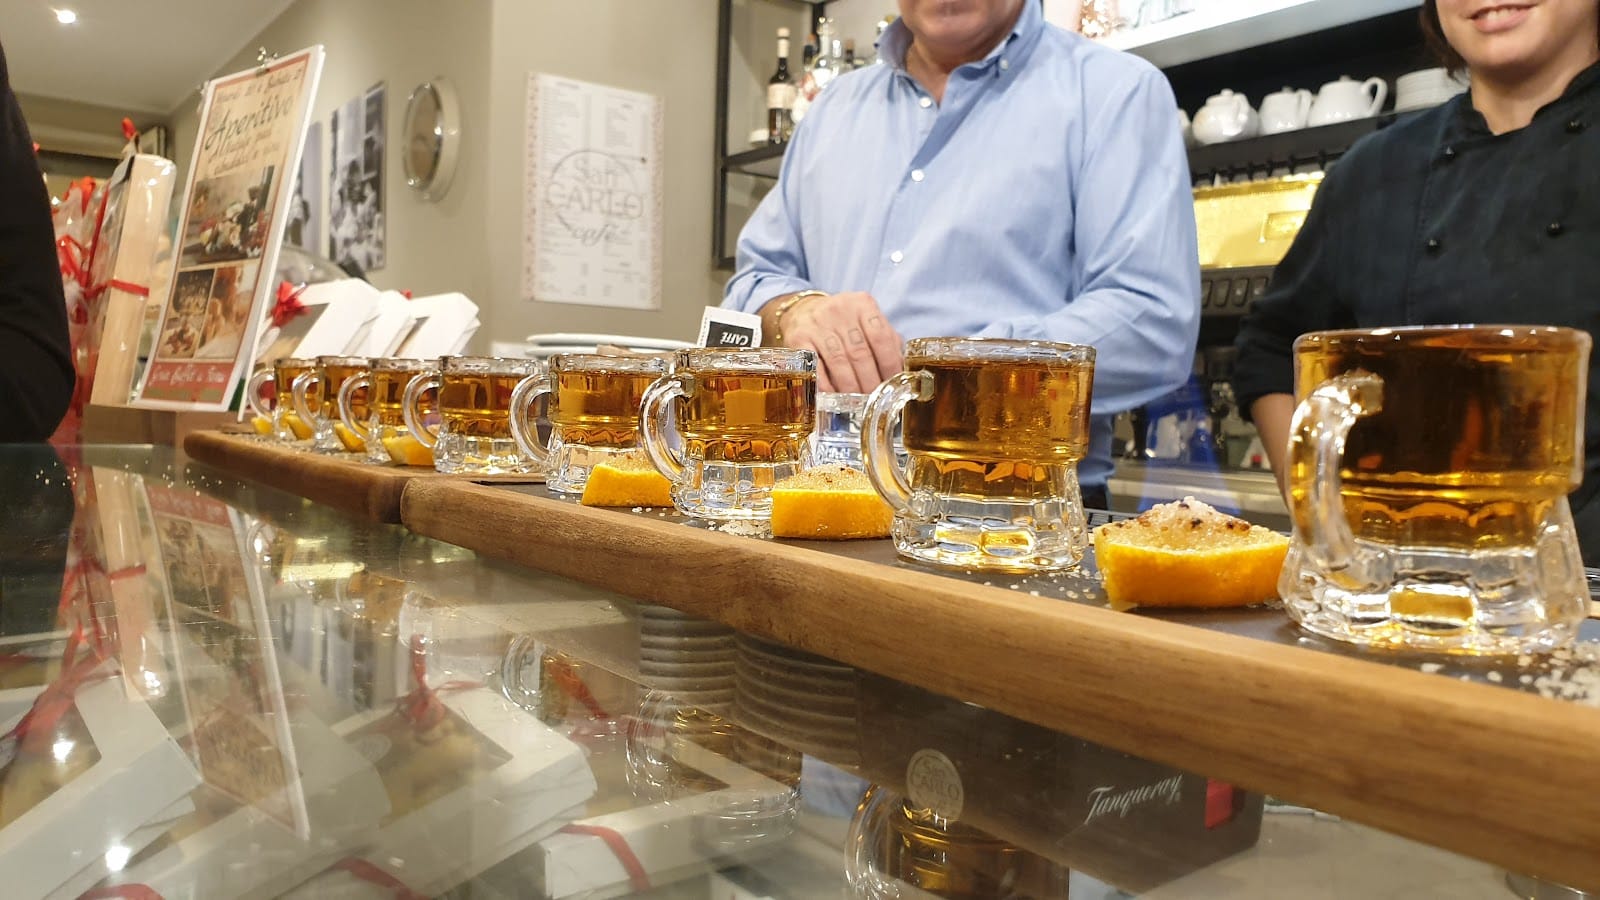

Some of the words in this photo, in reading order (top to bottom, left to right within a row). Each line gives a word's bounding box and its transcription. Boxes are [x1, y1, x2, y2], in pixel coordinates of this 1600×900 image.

[204, 94, 294, 164] Aperitivo
[545, 182, 645, 220] CARLO
[1083, 772, 1184, 826] Tanqueray
